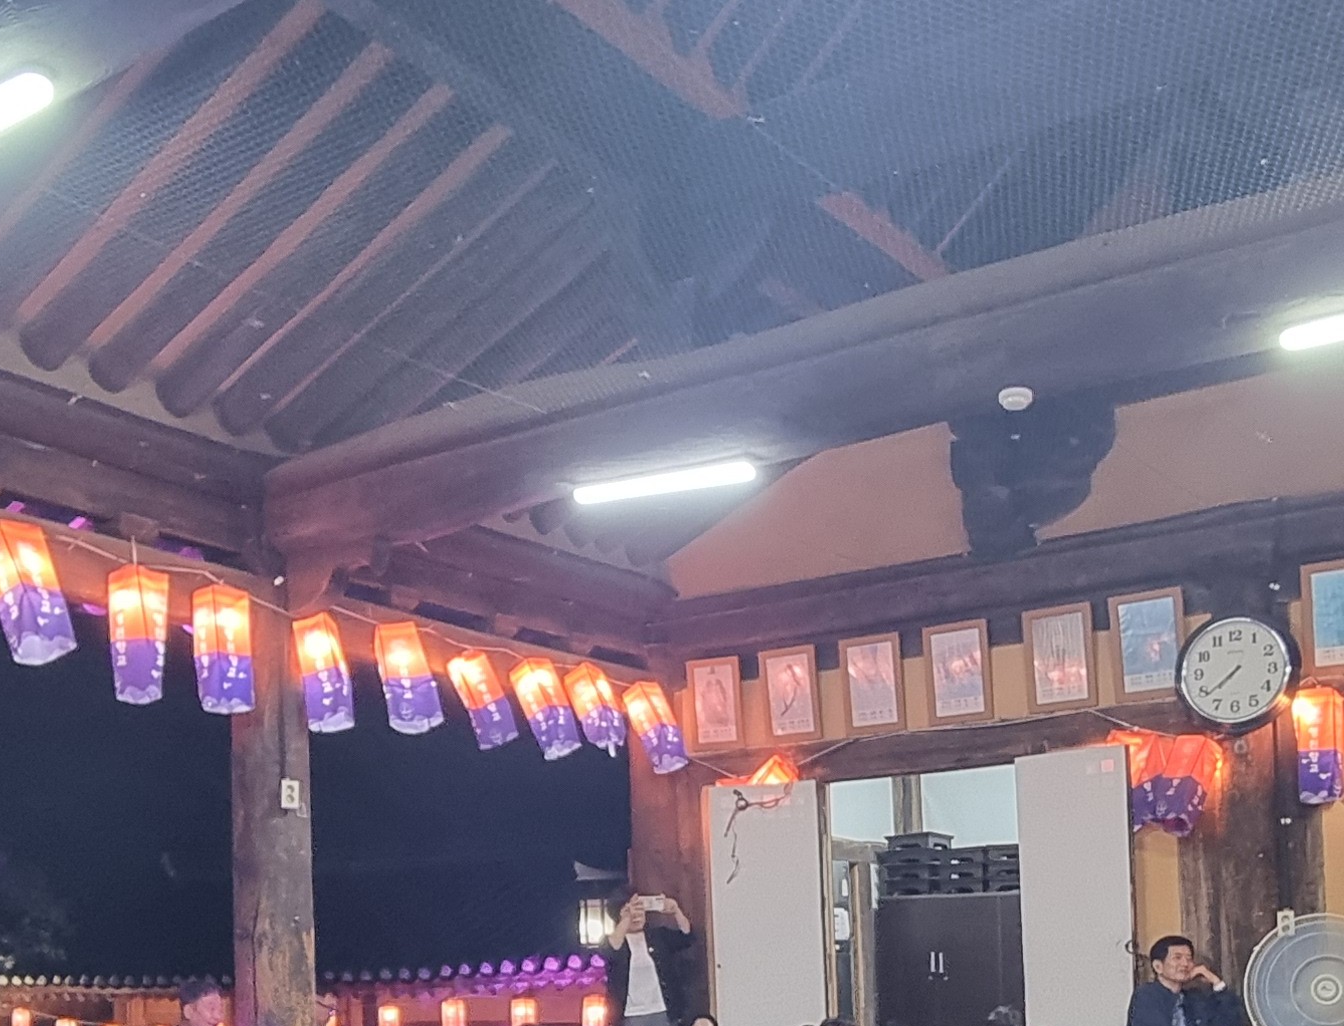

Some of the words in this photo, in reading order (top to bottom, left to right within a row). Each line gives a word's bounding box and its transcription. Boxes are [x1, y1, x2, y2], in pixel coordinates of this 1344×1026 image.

[1212, 635, 1223, 648] 11
[1229, 629, 1243, 642] 12
[1251, 632, 1257, 643] 1
[1198, 650, 1211, 663] 10
[1263, 644, 1275, 656] 2
[1267, 661, 1278, 674] 3
[1194, 668, 1205, 681] 9
[1198, 686, 1209, 698] 8
[1260, 679, 1272, 692] 4
[1212, 698, 1223, 711] 7
[1230, 700, 1241, 713] 6
[1248, 695, 1260, 707] 5
